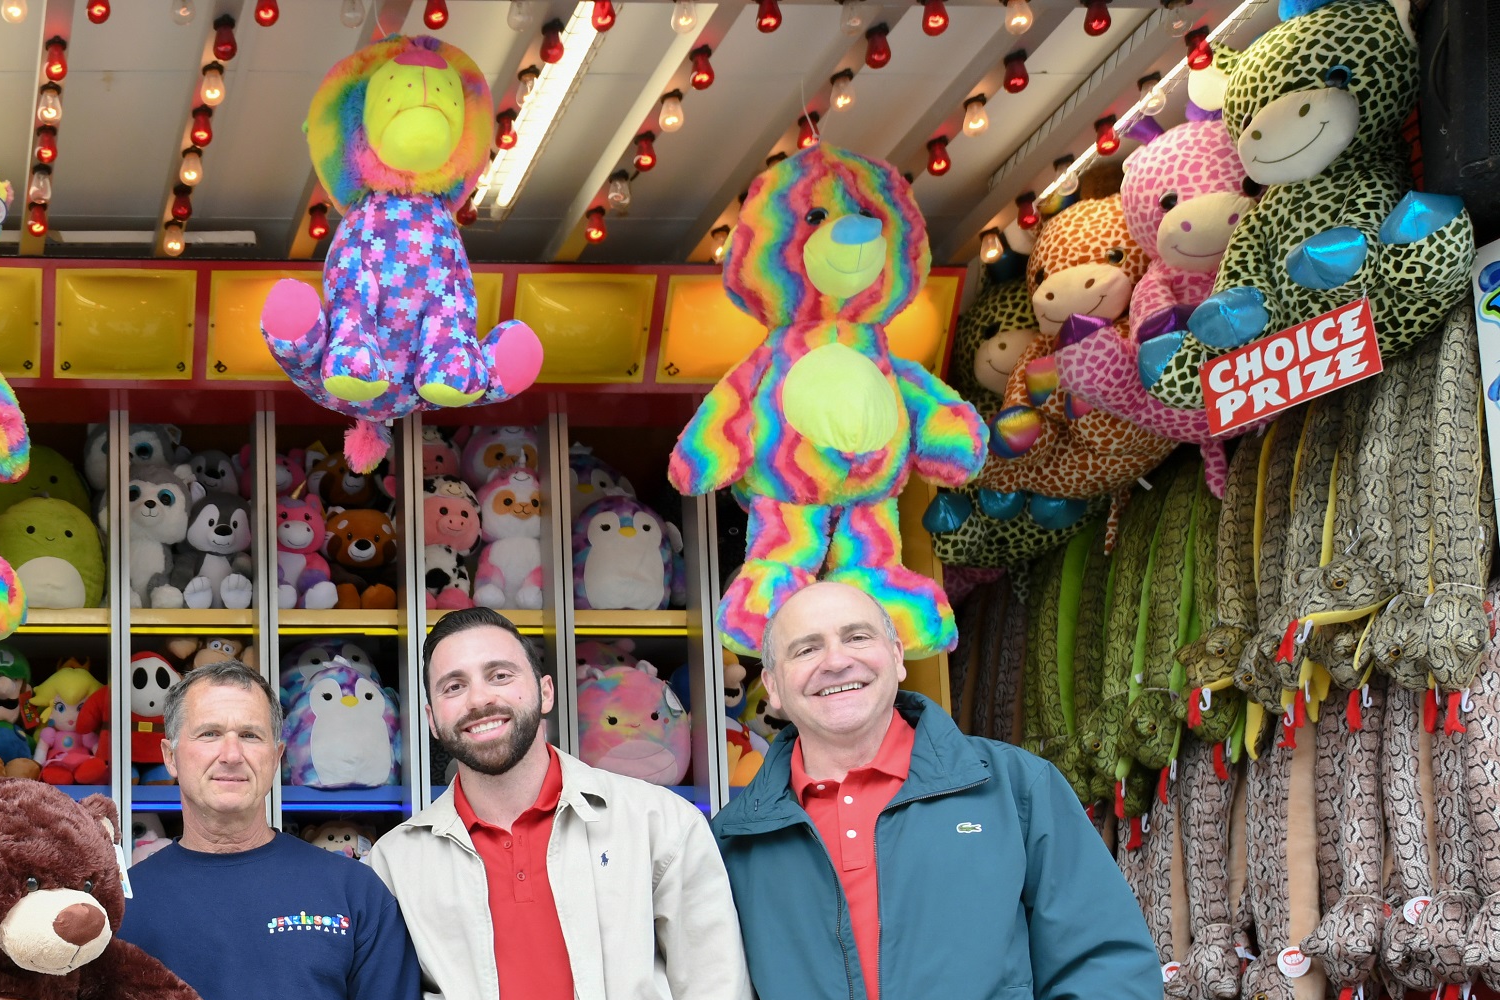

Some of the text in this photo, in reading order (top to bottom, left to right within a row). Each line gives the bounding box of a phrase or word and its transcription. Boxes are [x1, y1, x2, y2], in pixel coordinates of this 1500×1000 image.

[1208, 304, 1367, 394] CHOICE
[214, 360, 228, 373] 10
[664, 362, 680, 376] 13
[1215, 340, 1369, 427] PRIZE
[269, 925, 346, 935] BOARDWALK
